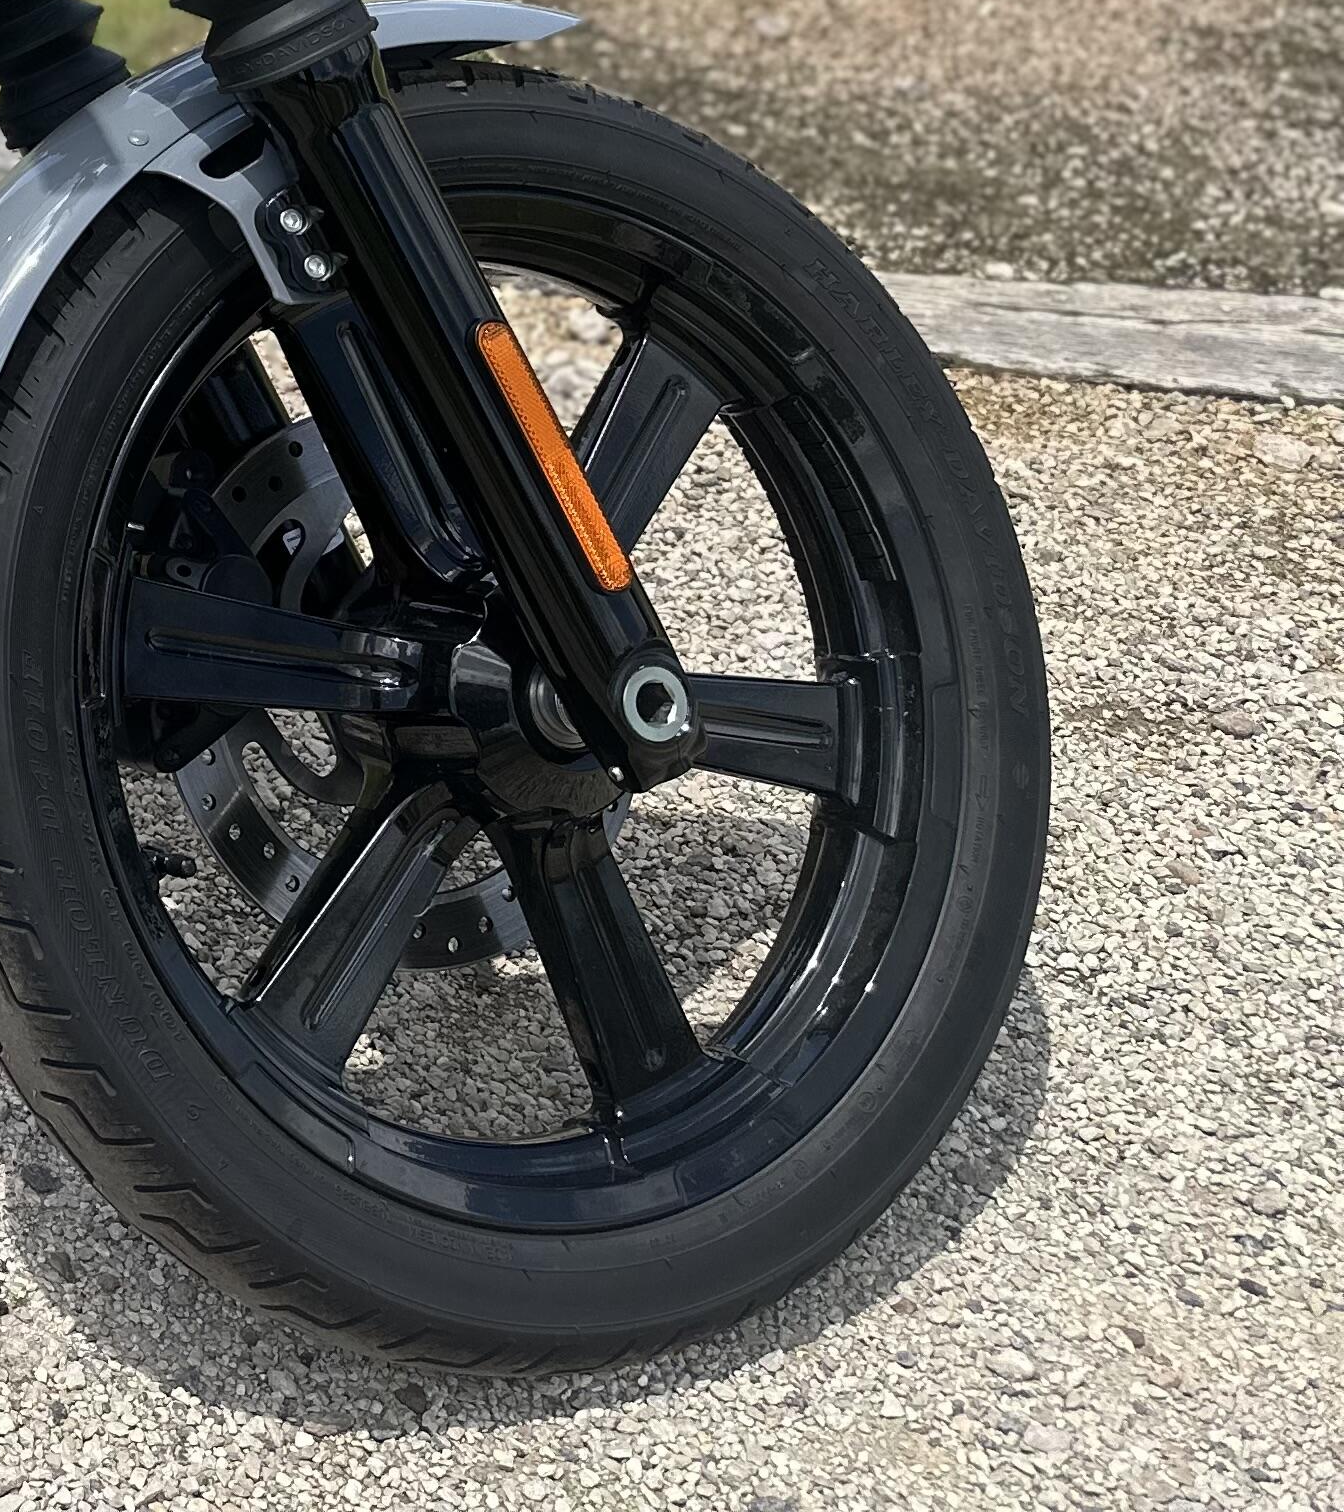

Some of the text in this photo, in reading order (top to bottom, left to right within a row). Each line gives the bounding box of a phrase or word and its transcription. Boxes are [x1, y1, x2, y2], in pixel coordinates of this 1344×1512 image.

[808, 255, 1025, 714] HARLEY-DAVIDSON
[21, 651, 174, 1084] DUNLOP D401F
